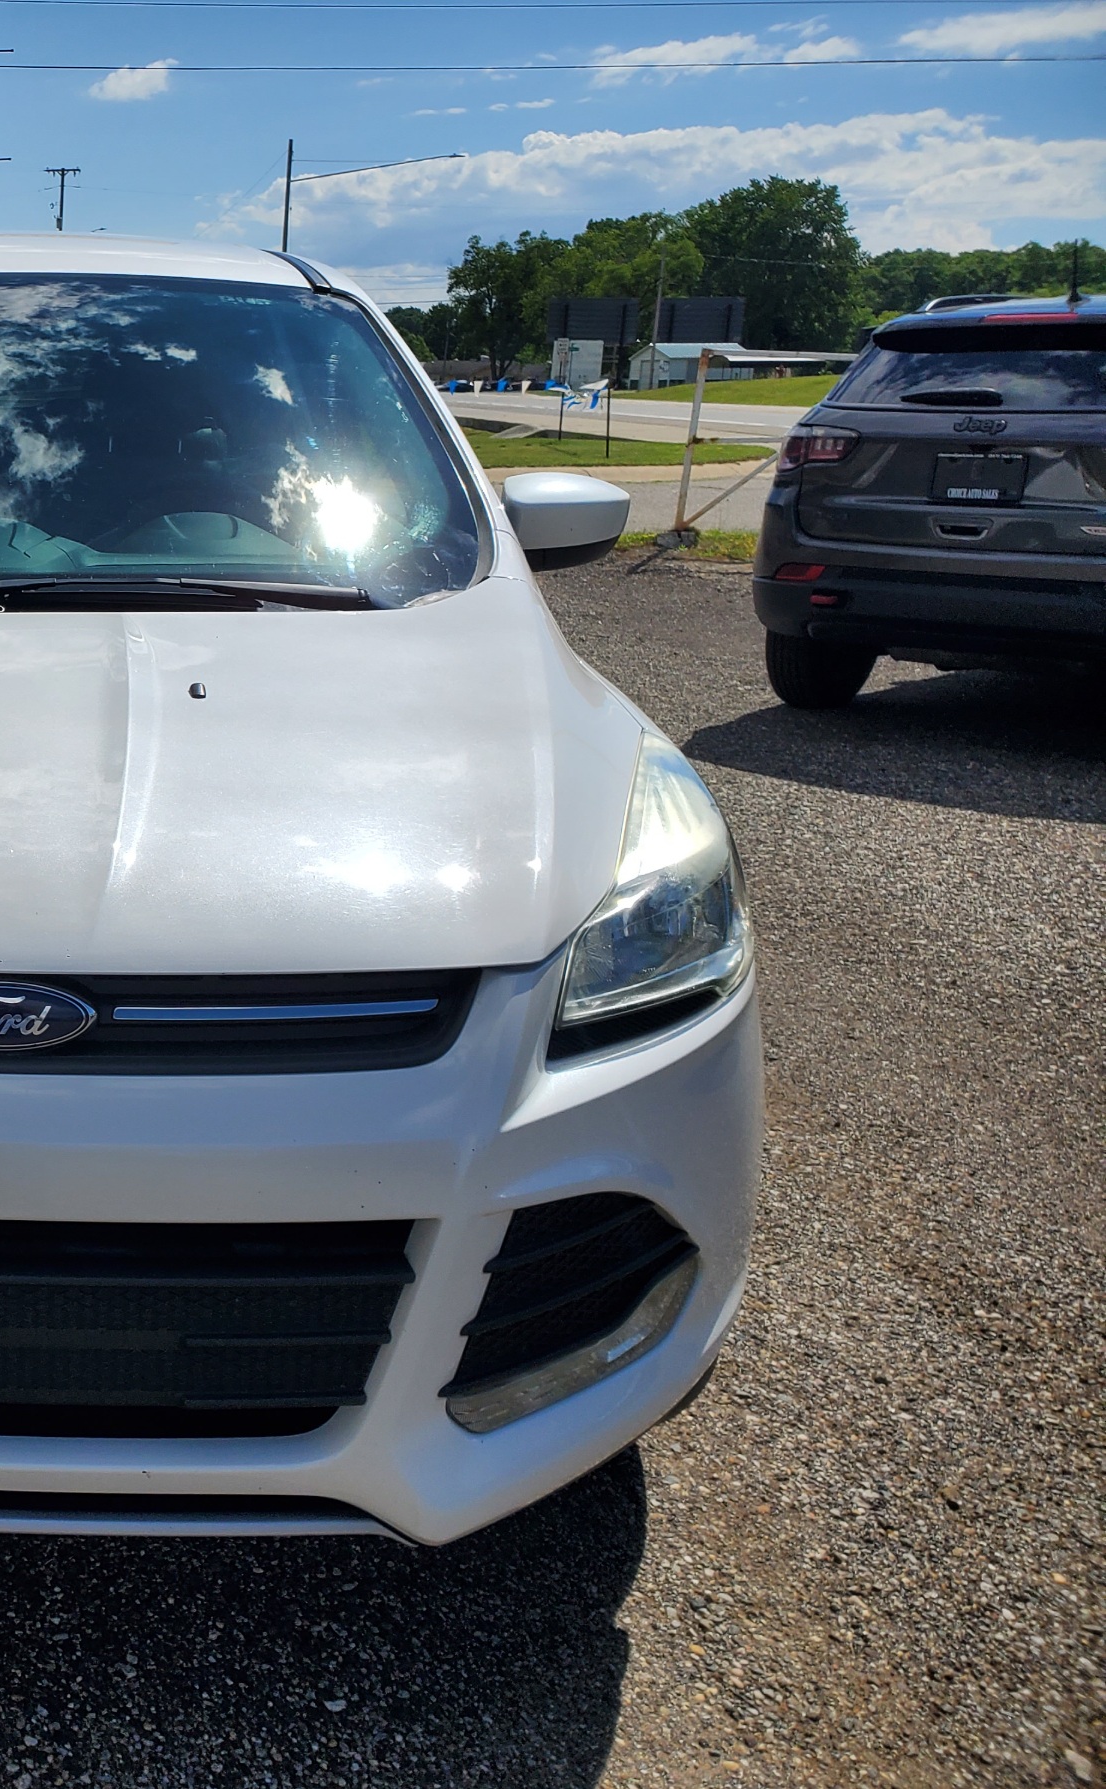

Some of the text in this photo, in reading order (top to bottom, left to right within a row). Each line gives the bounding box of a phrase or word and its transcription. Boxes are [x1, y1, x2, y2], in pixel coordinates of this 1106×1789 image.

[953, 416, 1008, 436] Jeep
[968, 488, 982, 498] AUTO
[982, 488, 999, 499] SALES
